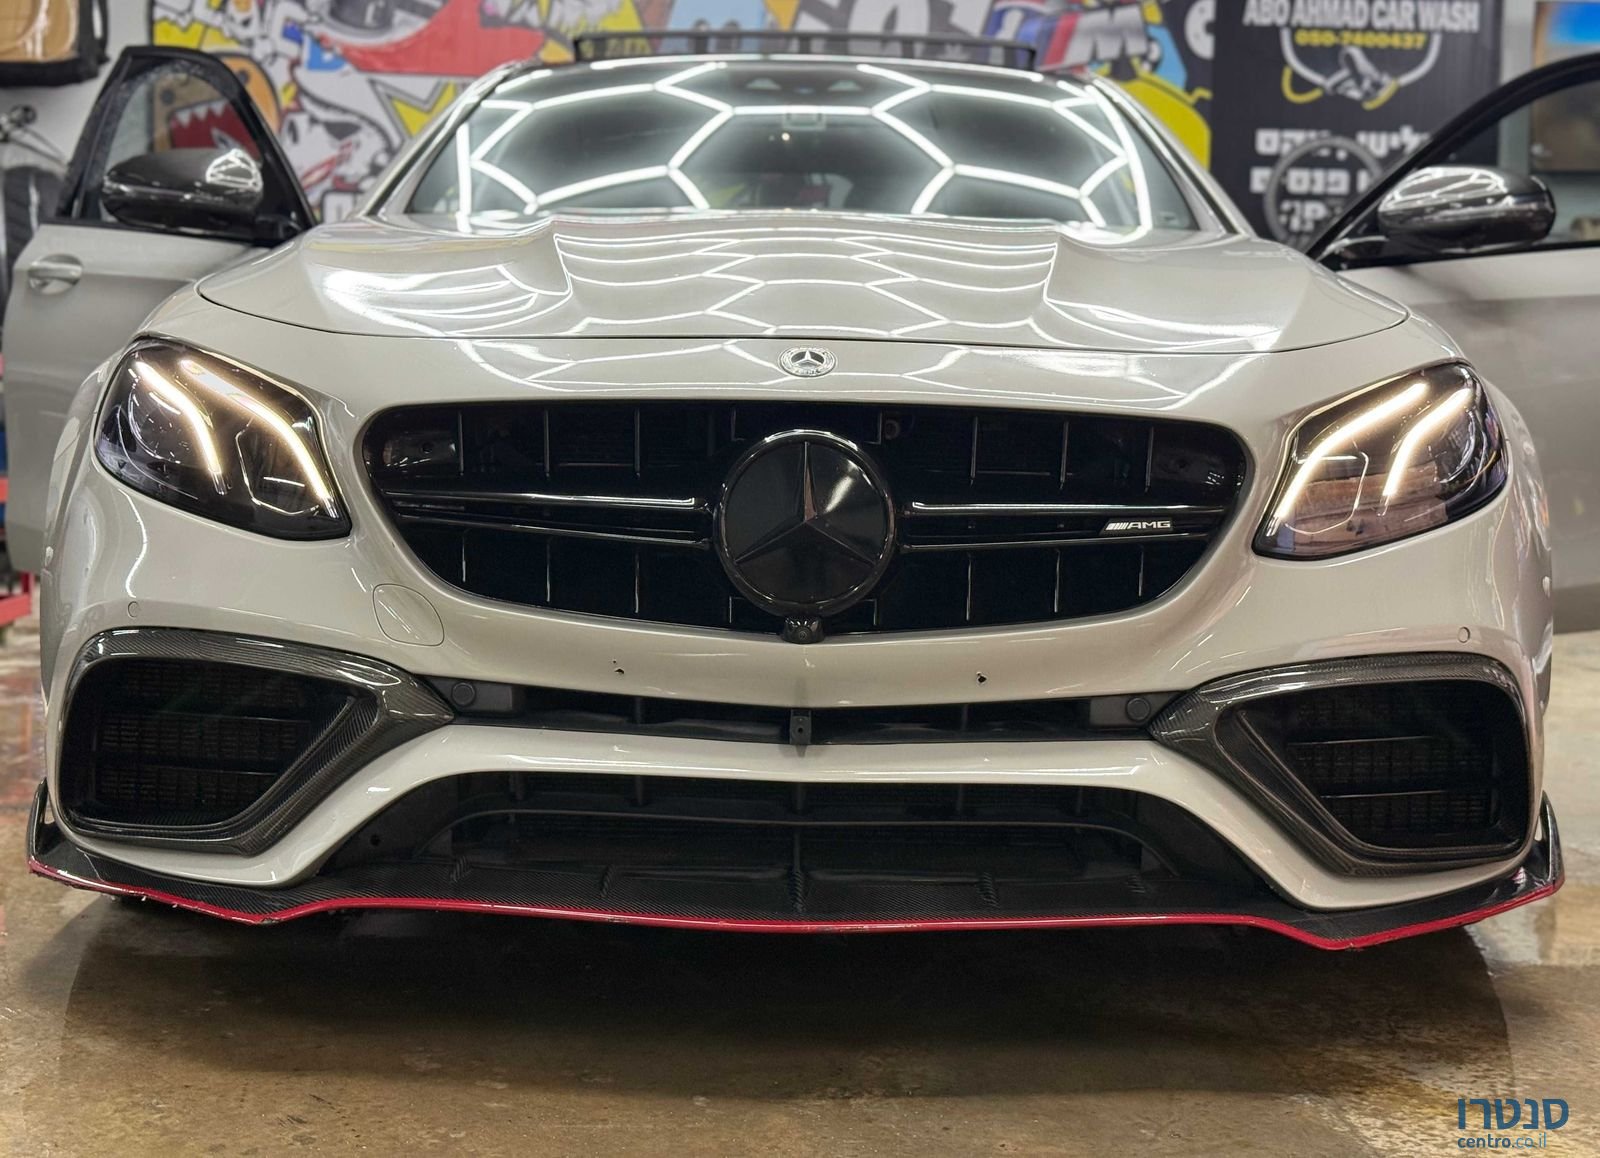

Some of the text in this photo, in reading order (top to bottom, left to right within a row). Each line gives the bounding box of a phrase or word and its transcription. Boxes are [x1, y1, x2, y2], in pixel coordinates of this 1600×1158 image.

[1242, 0, 1480, 33] ABO AHMAD CAR WASH
[1250, 166, 1350, 195] פנסם
[1127, 521, 1171, 529] AMG
